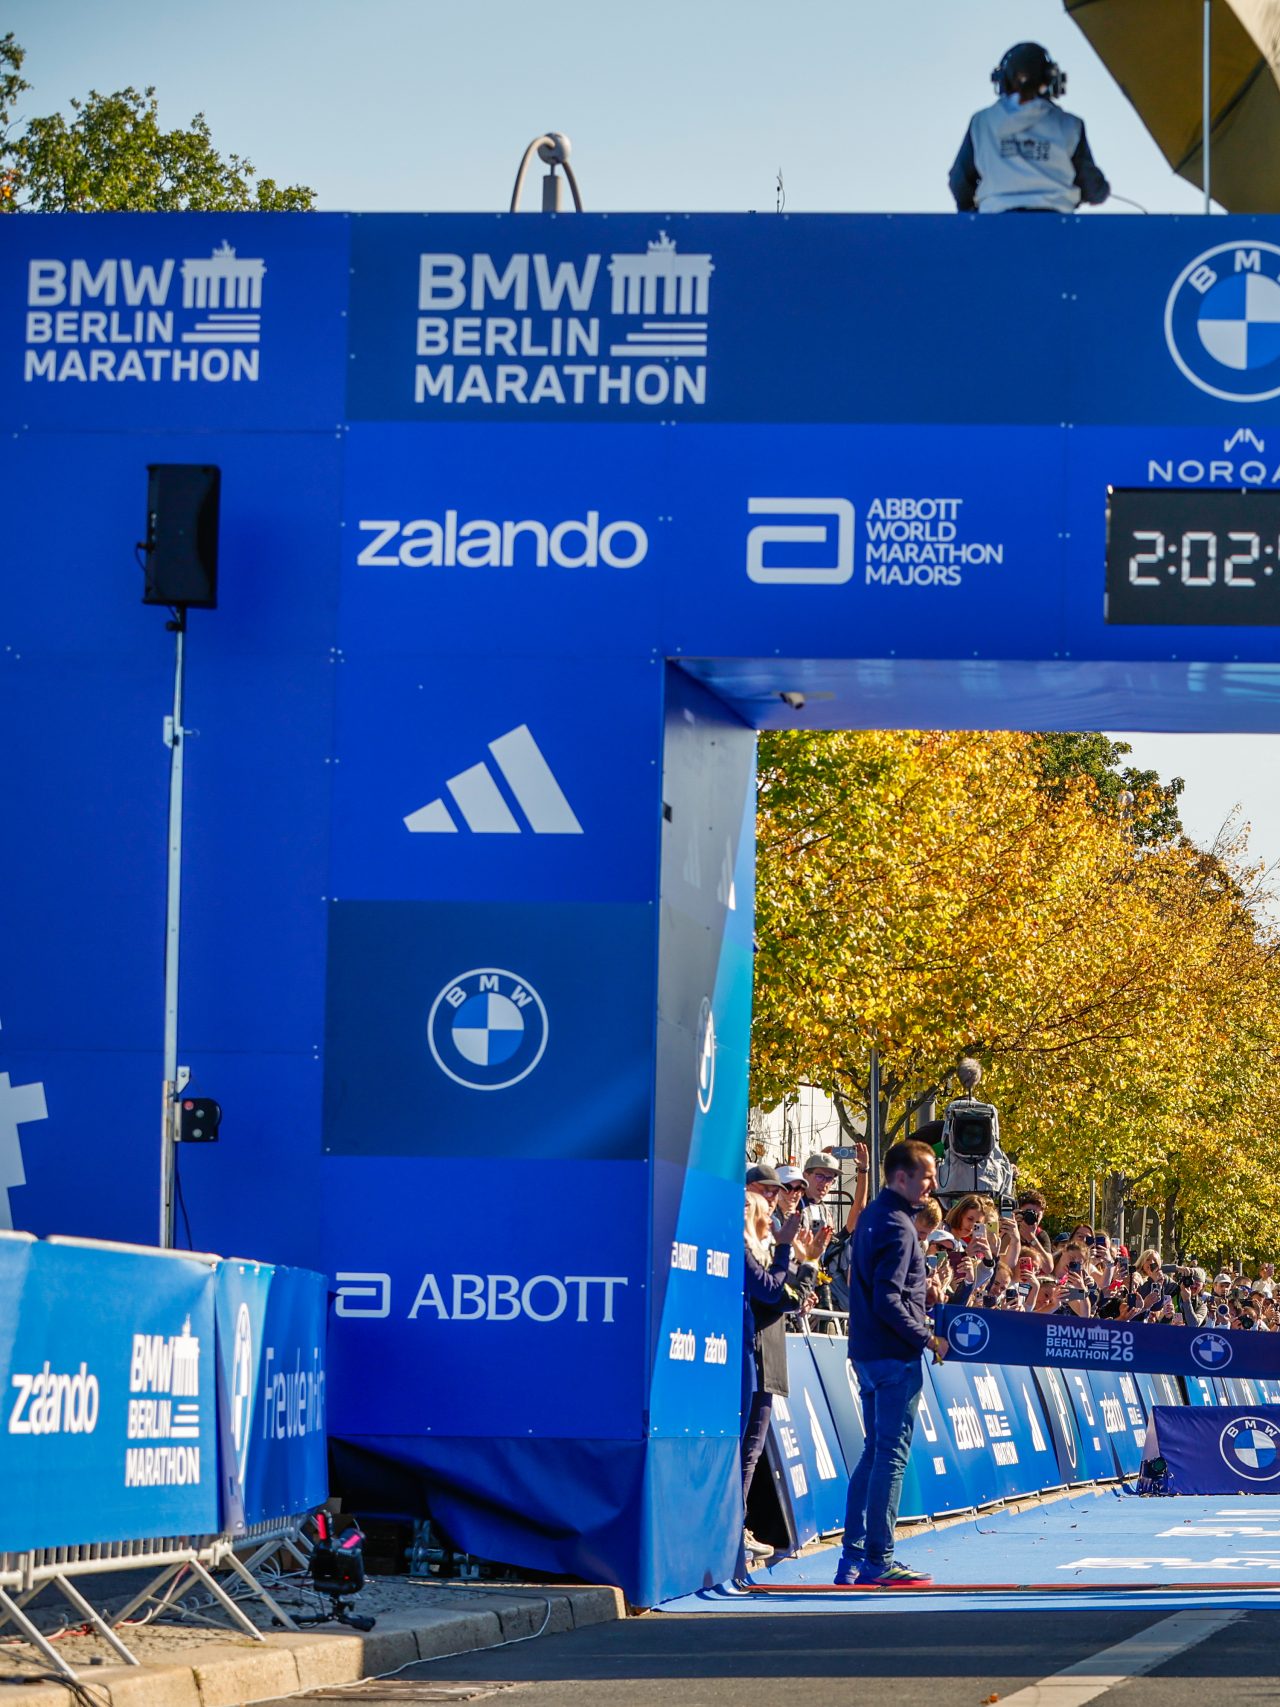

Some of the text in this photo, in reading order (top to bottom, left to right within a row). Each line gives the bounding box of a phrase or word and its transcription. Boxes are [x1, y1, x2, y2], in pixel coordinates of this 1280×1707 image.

[28, 259, 174, 306] BMW
[419, 254, 601, 310] BMW
[27, 311, 173, 344] BERLIN
[417, 318, 599, 356] BERLIN
[25, 349, 259, 382] MARATHON
[415, 365, 706, 404] MARATHON
[867, 498, 962, 520] ABBOTT
[357, 510, 648, 568] zalando
[866, 522, 956, 542] WORLD
[866, 545, 1003, 563] MARATHON
[866, 566, 961, 587] MAJORS
[446, 975, 532, 1008] BMW
[407, 1274, 628, 1322] ABBOTT
[954, 1314, 985, 1328] BMW
[1046, 1325, 1086, 1340] BMW
[1110, 1330, 1134, 1345] 20
[1046, 1338, 1087, 1349] BERLIN
[1046, 1348, 1110, 1361] MARATHON
[1110, 1345, 1134, 1362] 26
[1196, 1335, 1227, 1346] BMW
[130, 1334, 174, 1393] BMW
[262, 1347, 307, 1439] Freude
[127, 1400, 171, 1439] BERLIN
[1227, 1420, 1278, 1438] BMW
[125, 1446, 200, 1487] MARATHON
